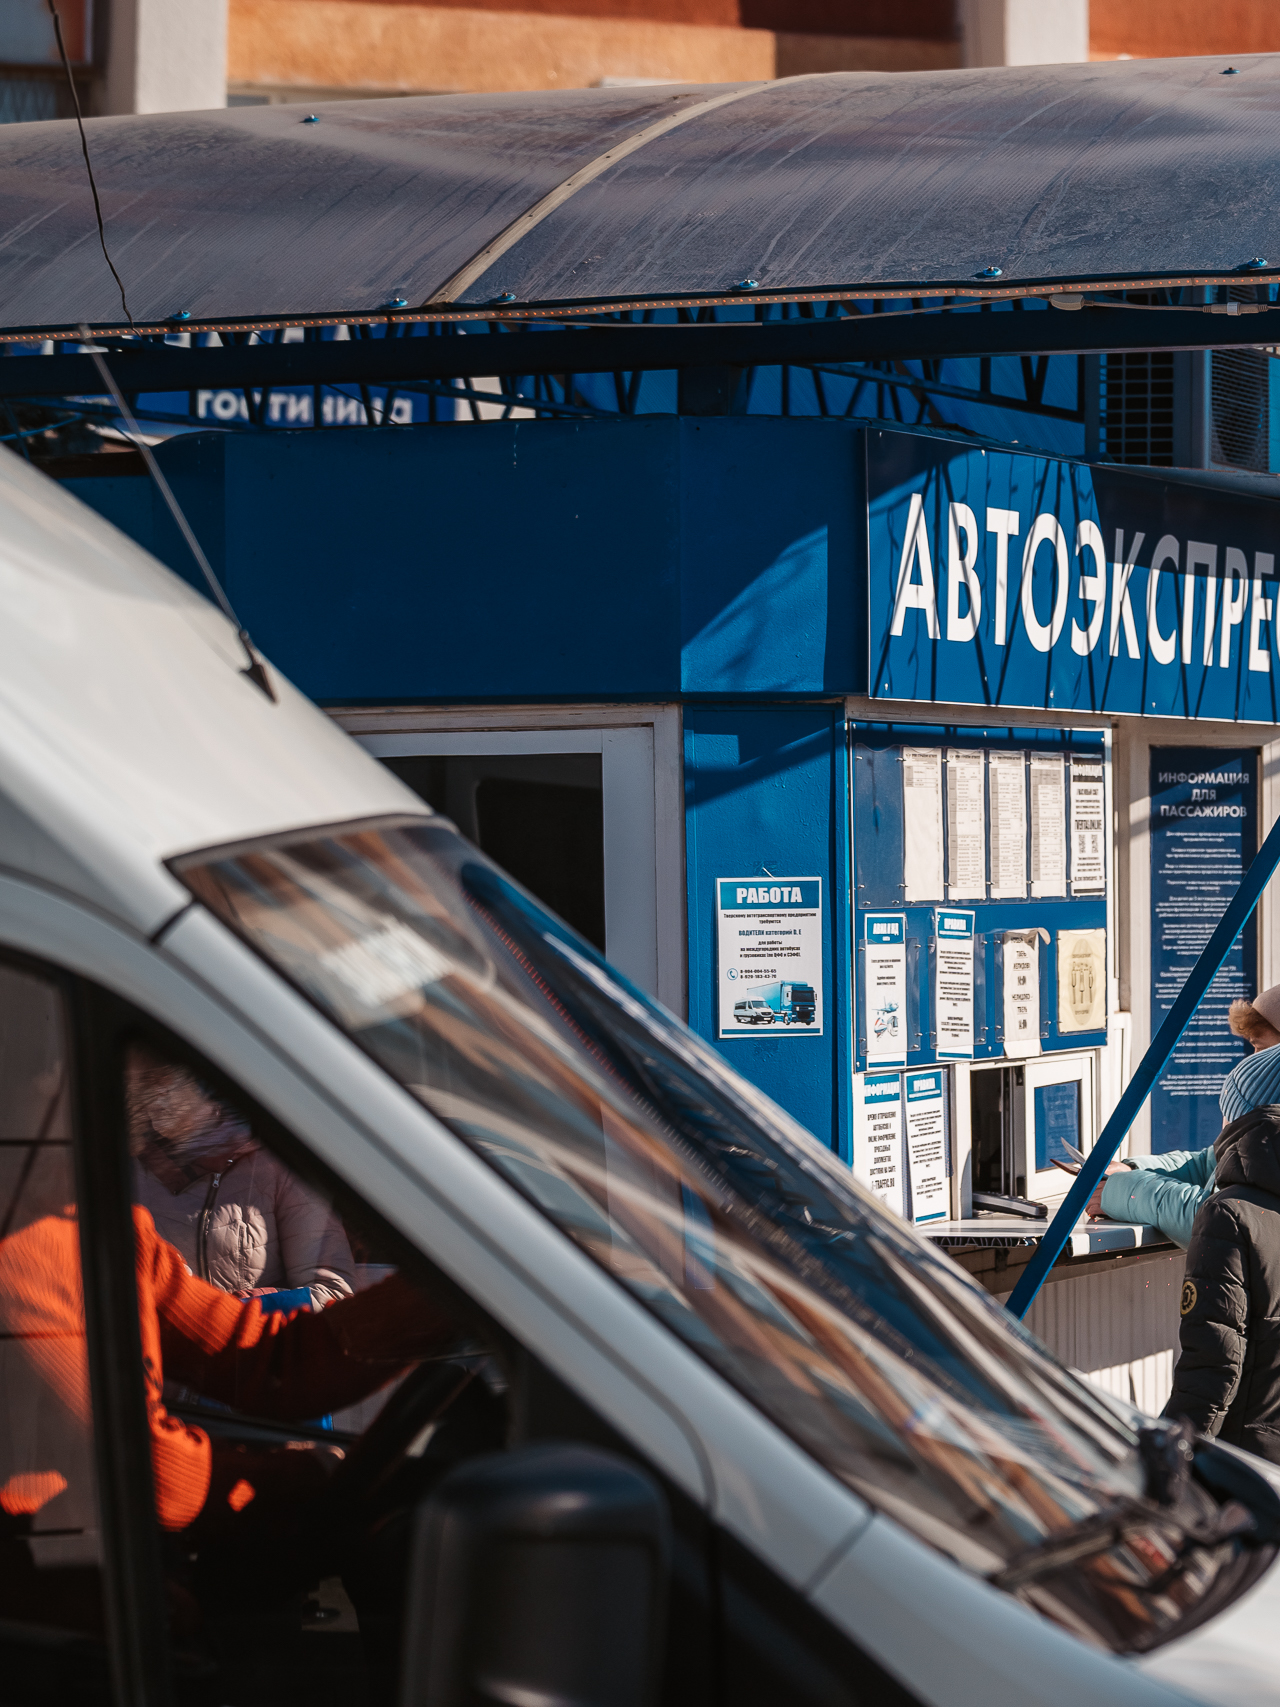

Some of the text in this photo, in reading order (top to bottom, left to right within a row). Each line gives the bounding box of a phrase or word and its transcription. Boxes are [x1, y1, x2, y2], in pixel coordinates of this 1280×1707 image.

[1158, 772, 1250, 786] ИНФОРМАЦИЯ
[1191, 789, 1217, 802] ДЛЯ
[1160, 805, 1248, 818] ПАССАЖИРОВ
[736, 886, 803, 904] РАБОТА
